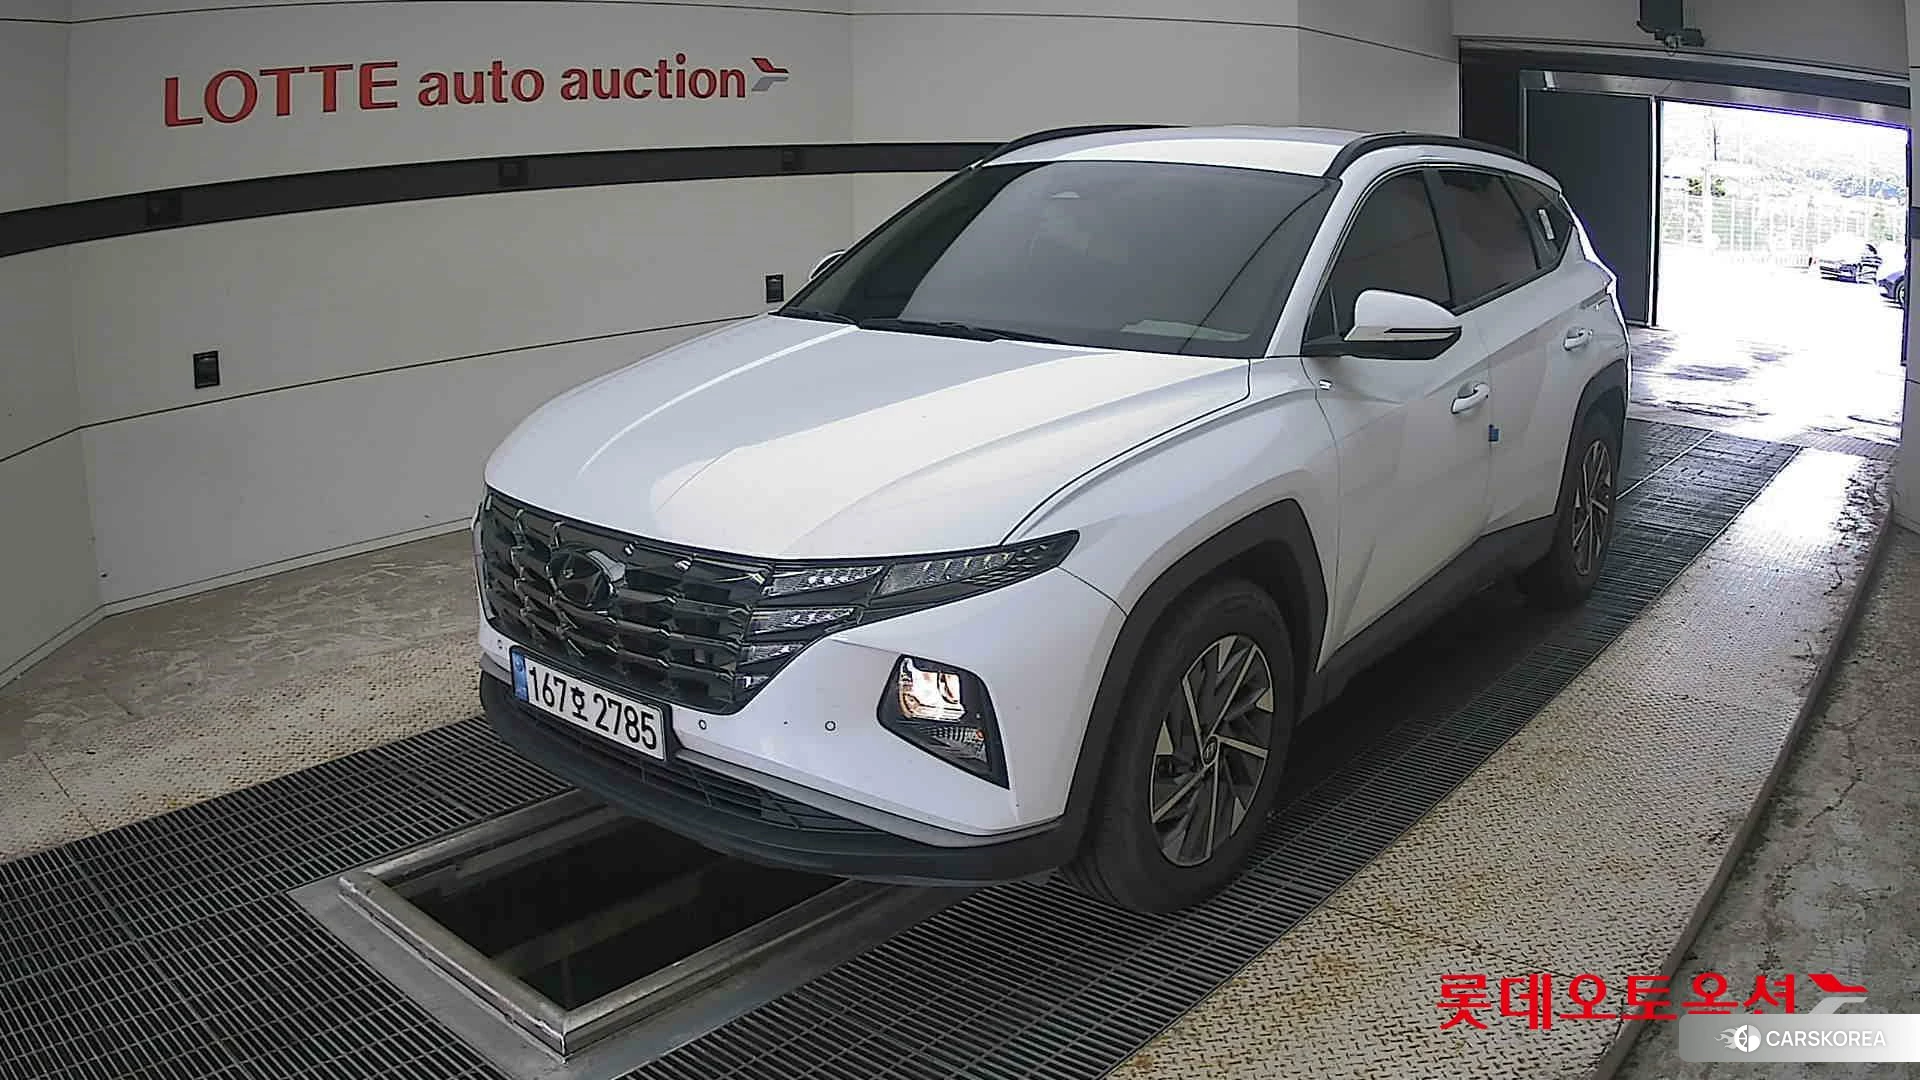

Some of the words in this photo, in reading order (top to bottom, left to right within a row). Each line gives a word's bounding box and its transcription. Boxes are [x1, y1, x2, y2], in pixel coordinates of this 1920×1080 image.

[164, 61, 399, 128] LOTTE
[417, 60, 545, 107] auto
[560, 53, 747, 101] auction
[593, 693, 657, 750] 2785
